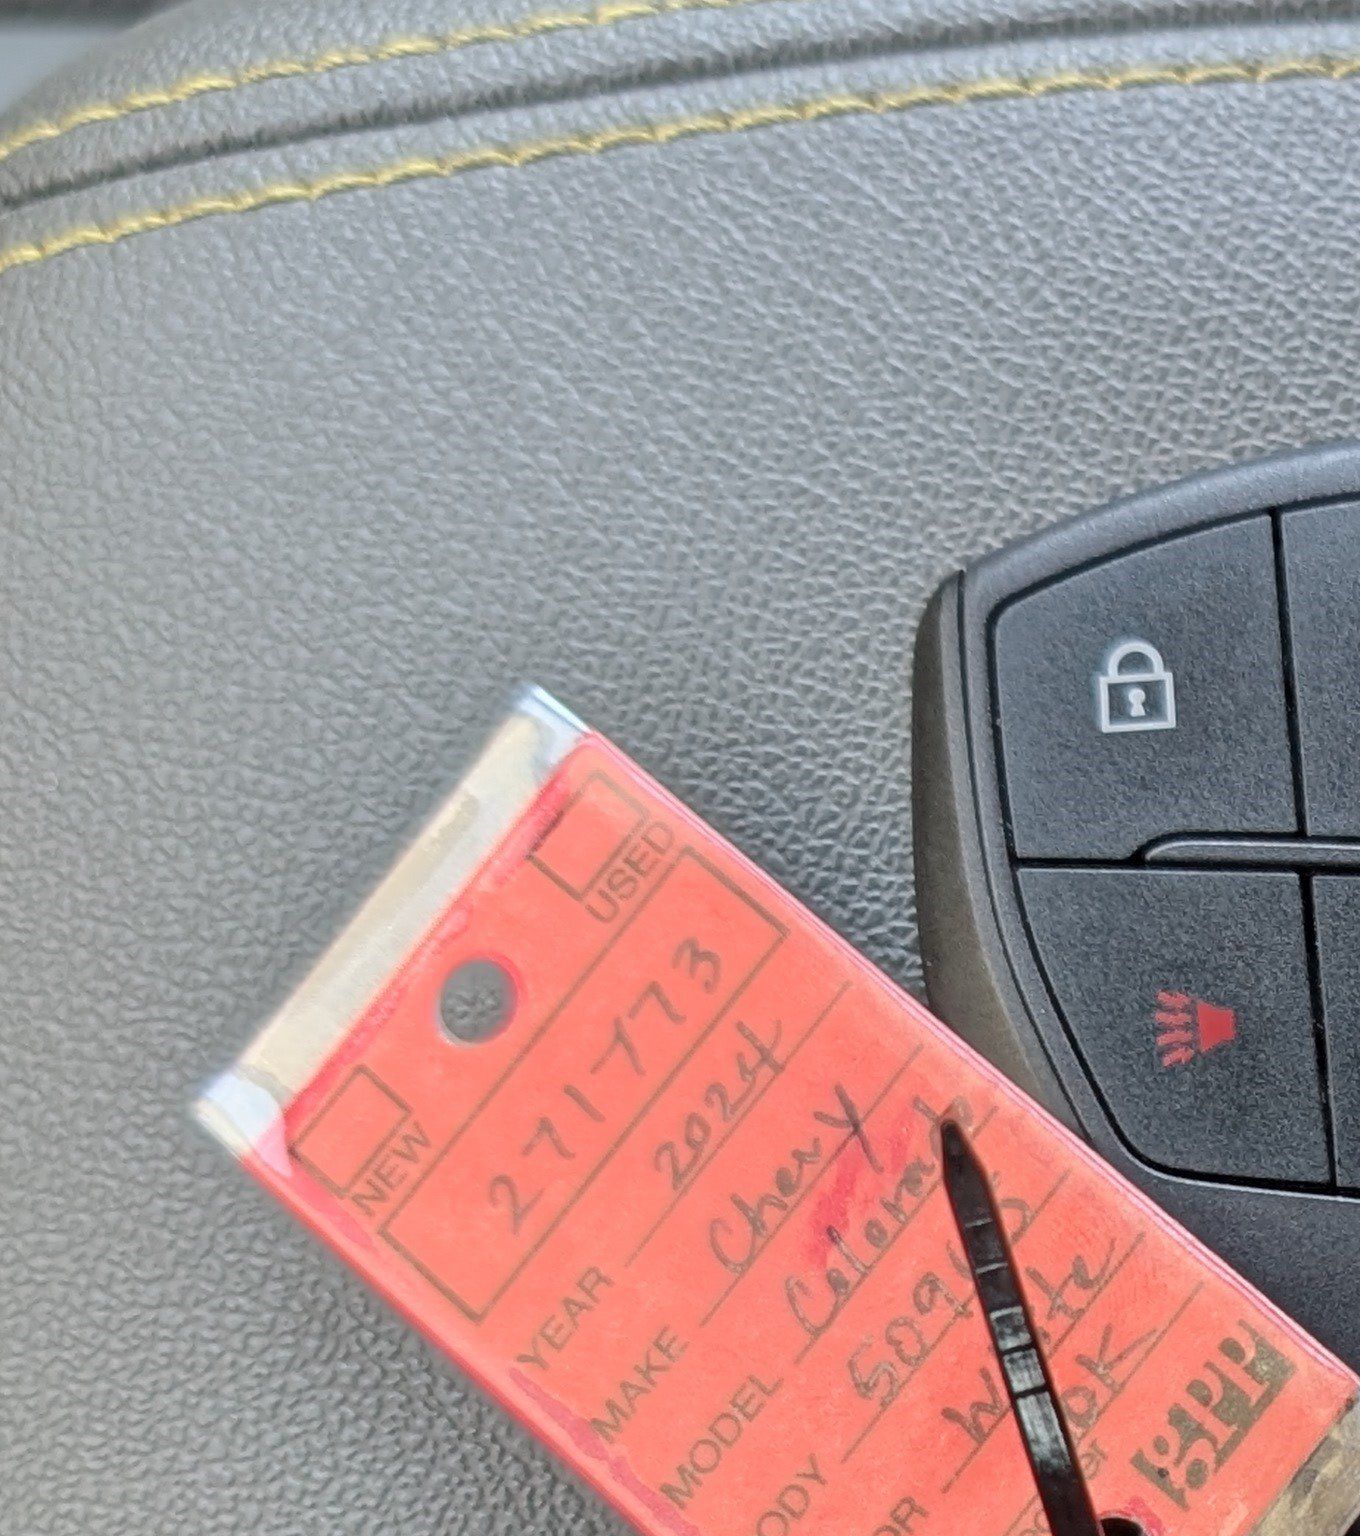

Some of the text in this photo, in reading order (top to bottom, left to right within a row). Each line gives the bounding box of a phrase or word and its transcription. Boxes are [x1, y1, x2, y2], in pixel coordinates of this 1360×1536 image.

[585, 819, 675, 924] USED
[489, 935, 723, 1235] 271773
[653, 1019, 783, 1191] 2024
[353, 1122, 435, 1216] NEW
[515, 1265, 615, 1372] YEAR
[588, 1325, 689, 1444] MAKE
[659, 1374, 784, 1508] MODEL
